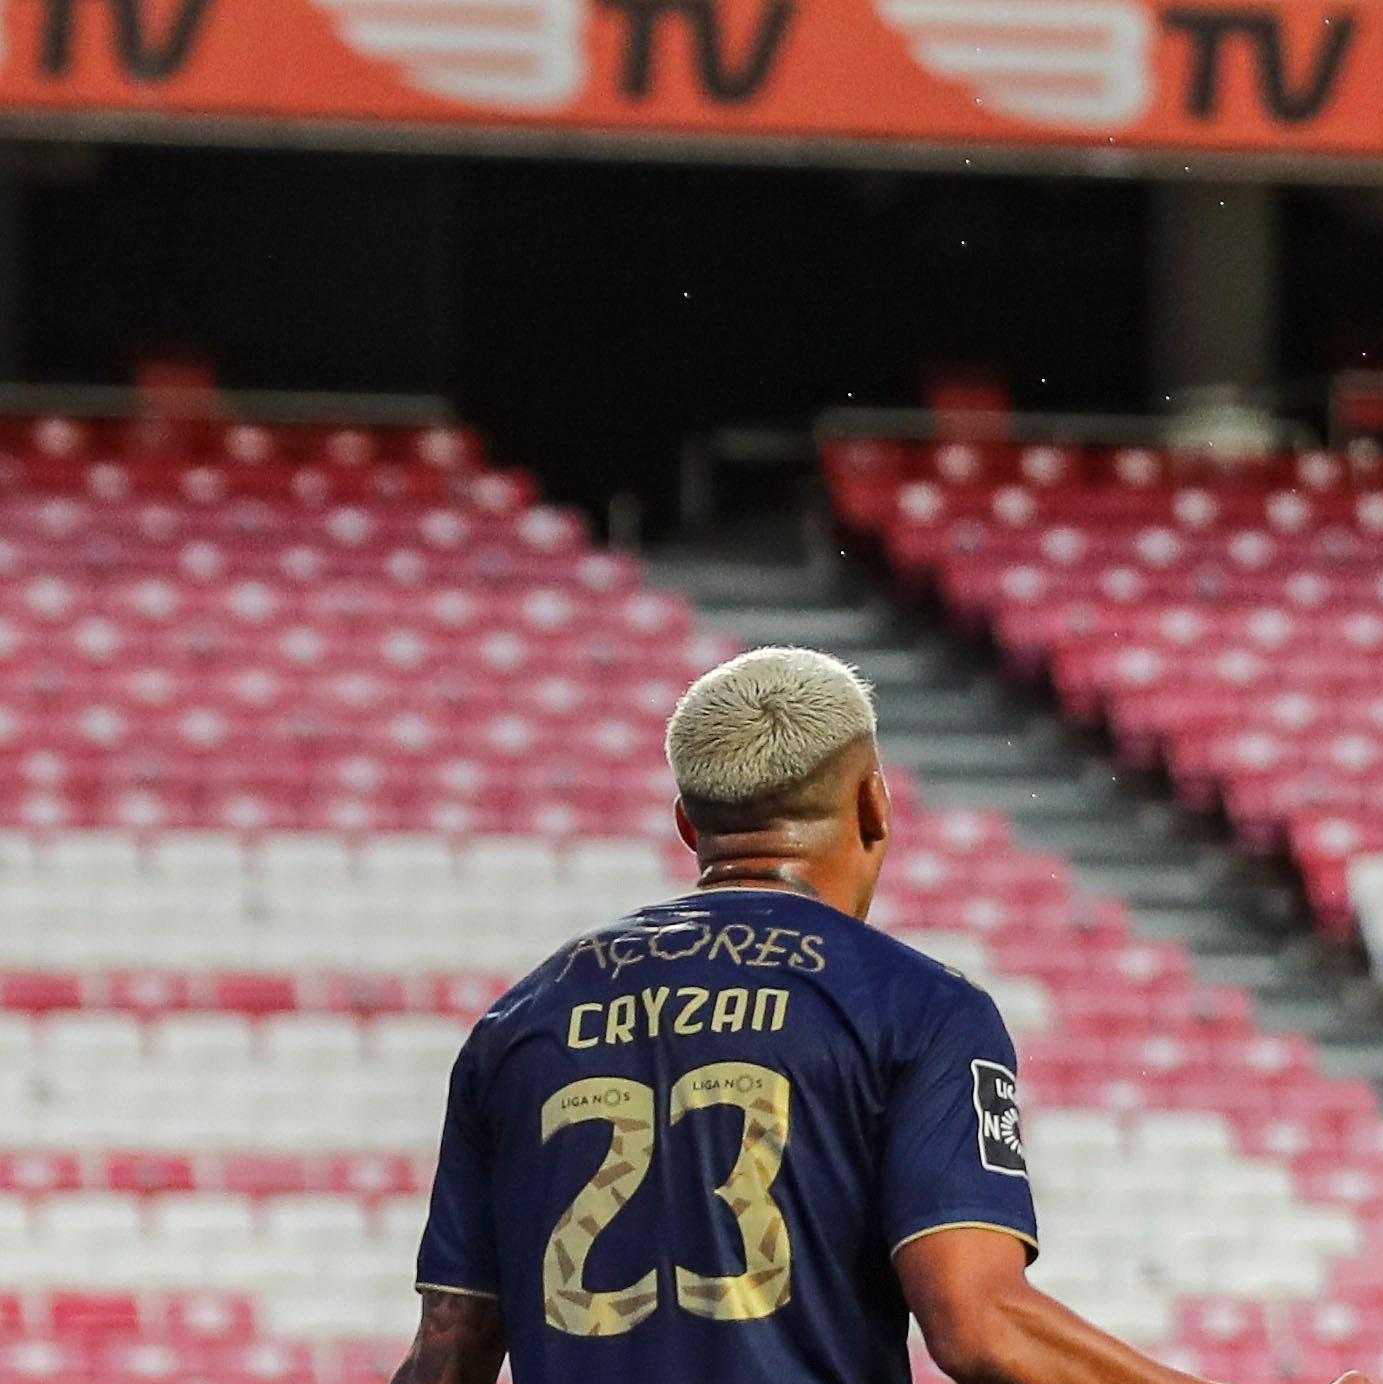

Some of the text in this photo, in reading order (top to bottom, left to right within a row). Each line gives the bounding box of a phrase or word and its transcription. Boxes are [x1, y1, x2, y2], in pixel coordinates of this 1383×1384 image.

[556, 921, 825, 982] AÇORES
[567, 985, 789, 1049] CRYZAN
[561, 1096, 588, 1109] LIGA
[692, 1078, 720, 1091] LIGA
[541, 1061, 791, 1337] 23
